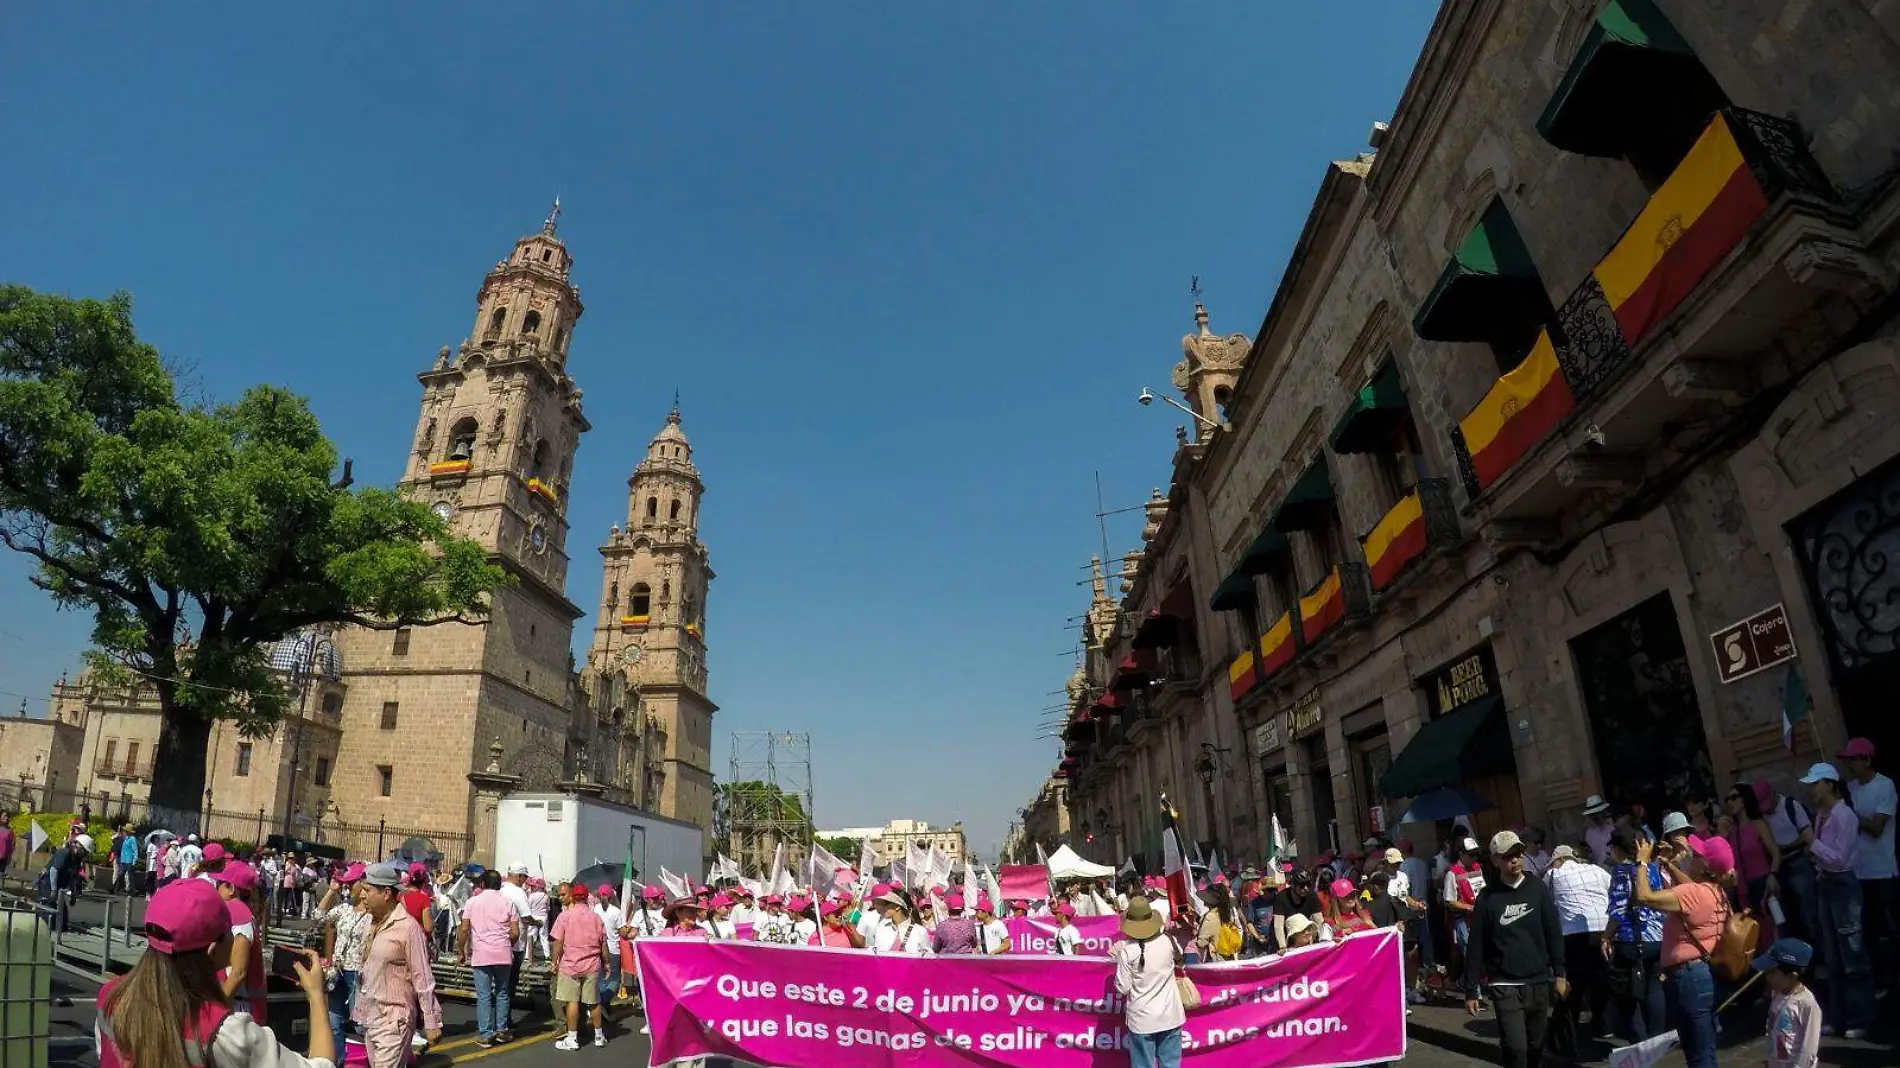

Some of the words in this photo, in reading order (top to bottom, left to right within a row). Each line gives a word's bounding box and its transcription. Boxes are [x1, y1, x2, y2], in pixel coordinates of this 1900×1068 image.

[1450, 655, 1483, 687] BEER
[1504, 903, 1528, 917] NIKE
[717, 974, 777, 1001] Que
[784, 983, 845, 1005] este
[852, 987, 868, 1008] 2
[875, 989, 914, 1013] de
[920, 988, 999, 1018] junio
[1007, 993, 1045, 1016] ya
[1053, 993, 1128, 1014] nadi
[722, 1019, 778, 1041] que
[786, 1014, 829, 1039] las
[836, 1025, 926, 1050] ganas
[934, 1028, 972, 1050] de
[980, 1025, 1048, 1050] salir
[1208, 1026, 1260, 1047] nos
[1266, 1016, 1348, 1038] unan.
